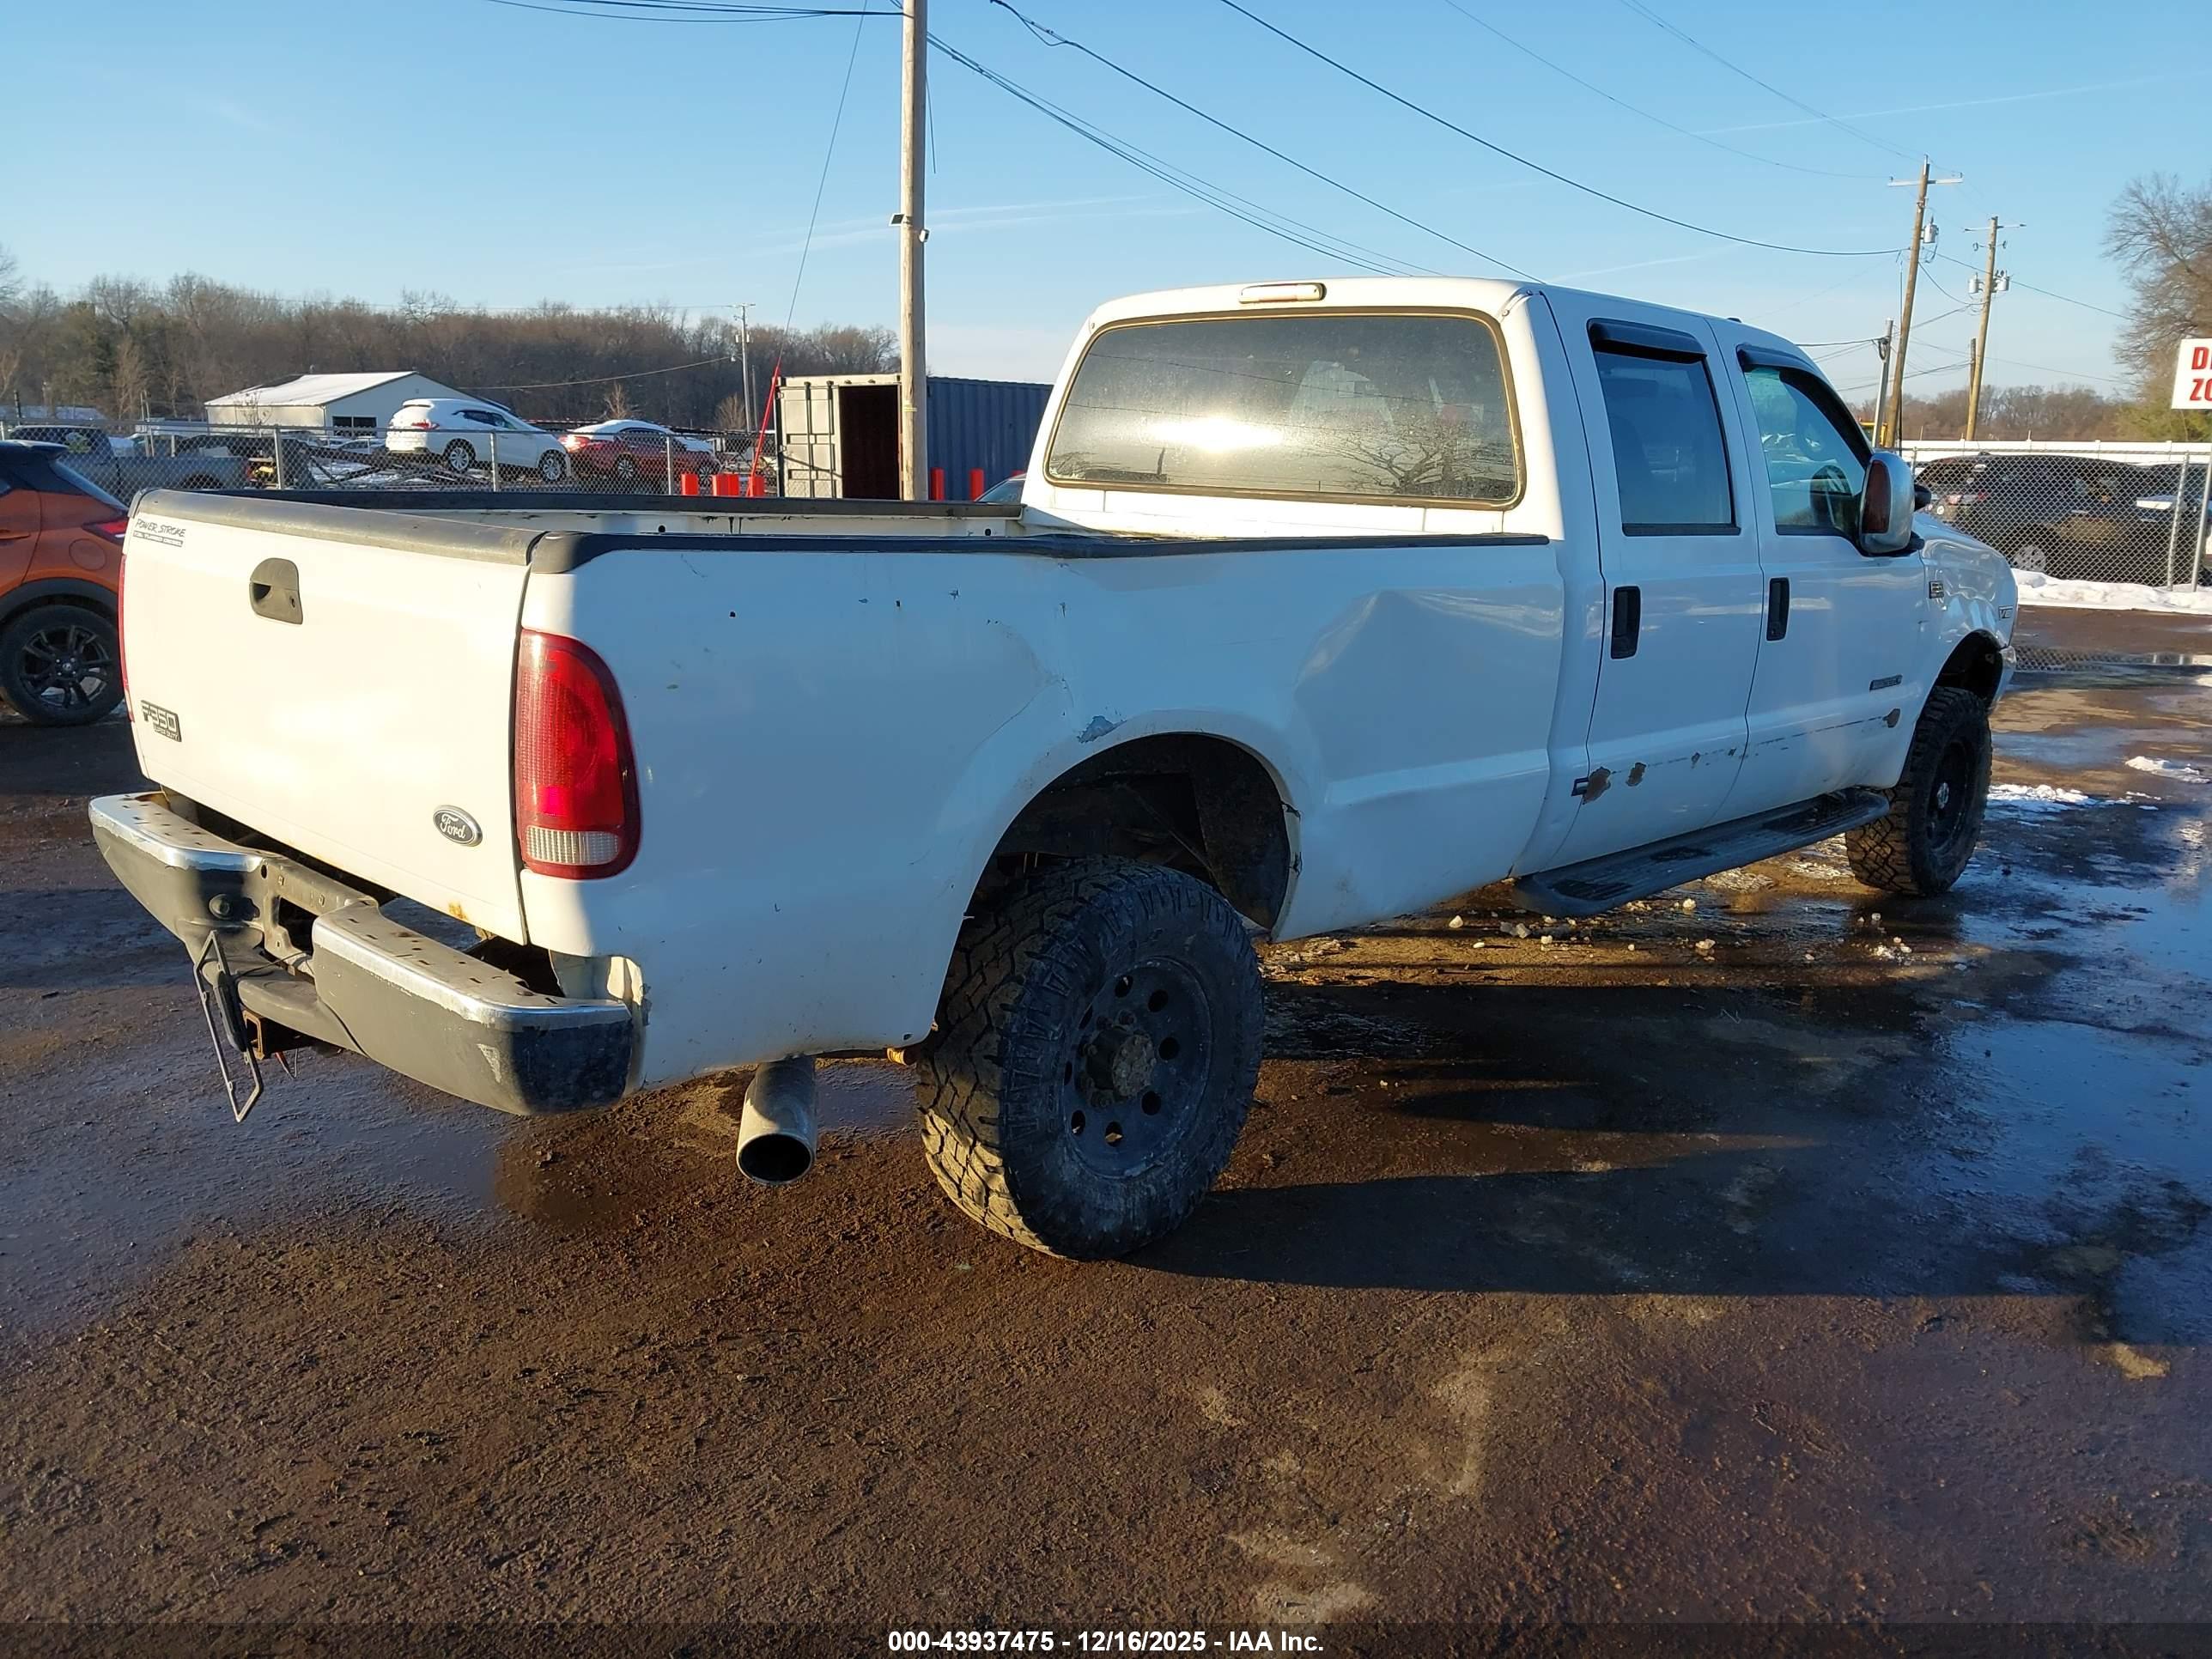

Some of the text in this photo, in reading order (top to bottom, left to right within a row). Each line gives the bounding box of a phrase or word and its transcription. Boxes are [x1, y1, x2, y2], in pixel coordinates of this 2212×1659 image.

[2191, 347, 2212, 369] D
[135, 519, 185, 537] POWER STROKE
[440, 813, 466, 839] Ford
